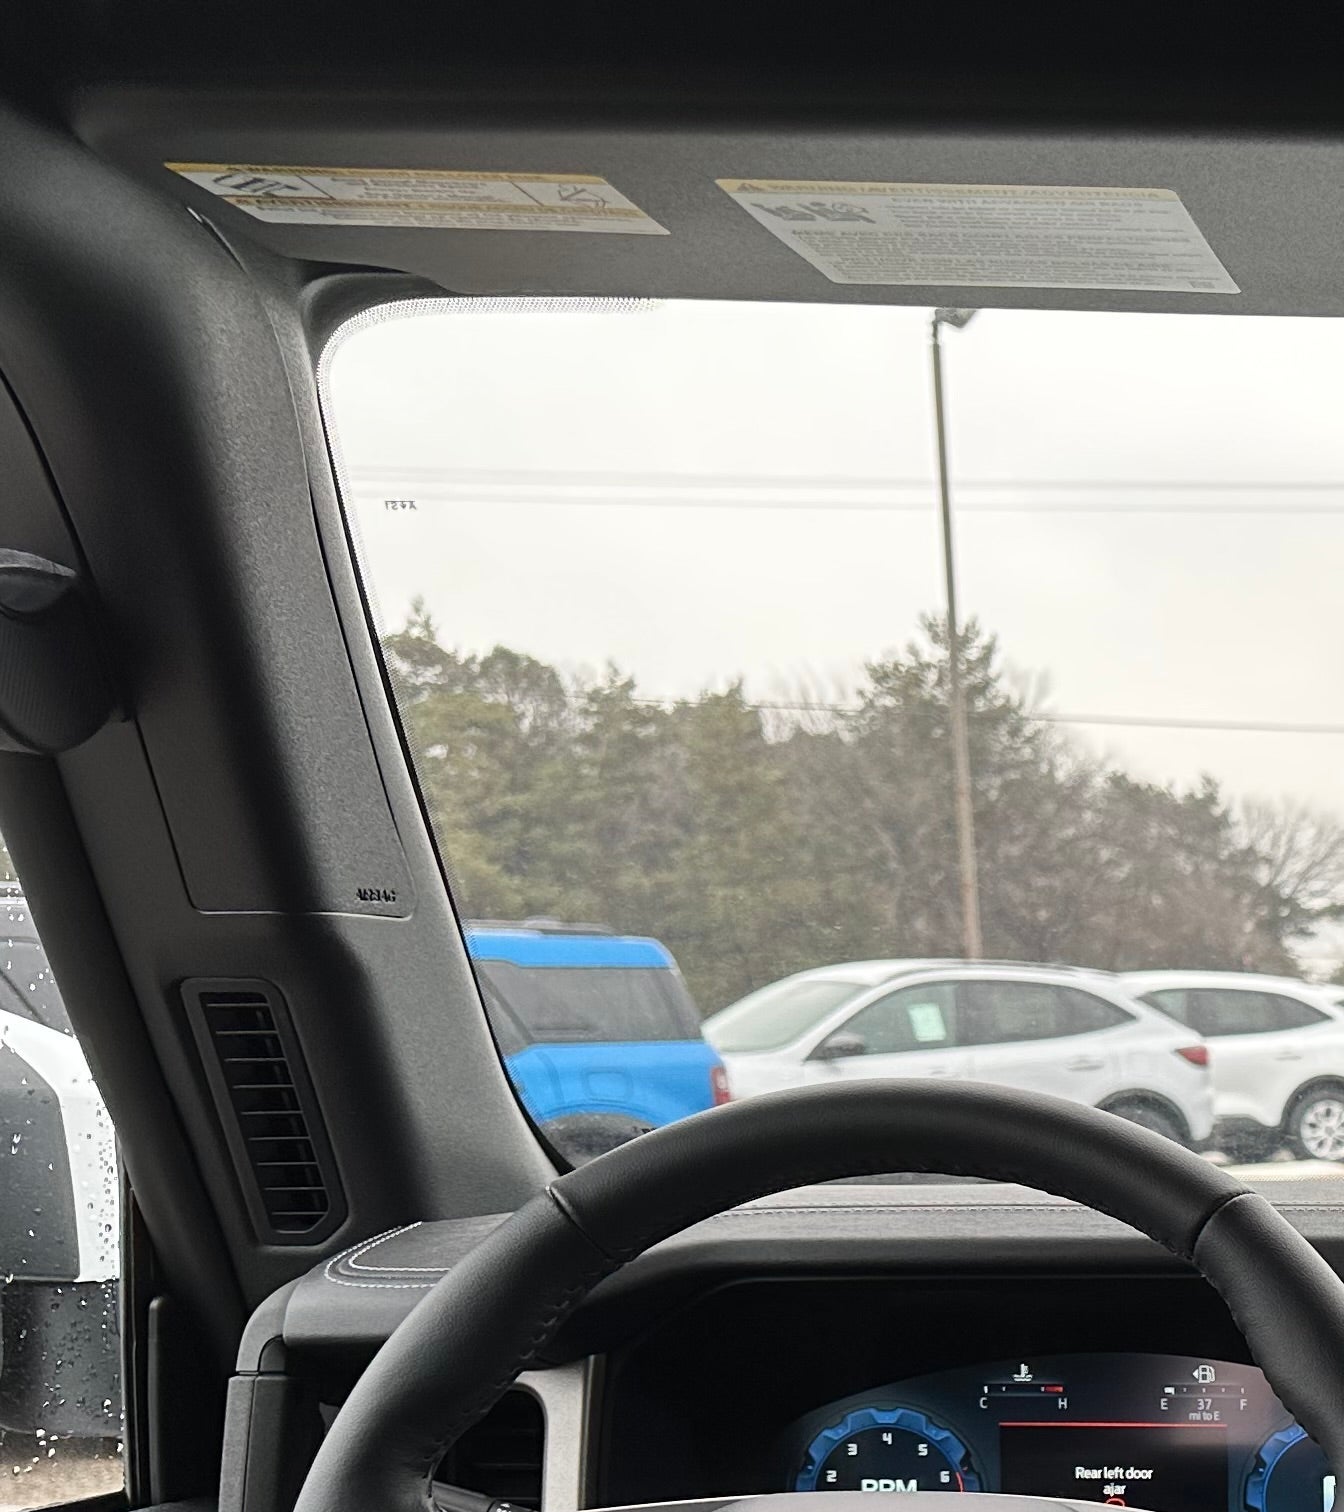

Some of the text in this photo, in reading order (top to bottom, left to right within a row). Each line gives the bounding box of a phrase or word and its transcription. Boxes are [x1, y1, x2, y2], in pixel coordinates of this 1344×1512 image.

[979, 1398, 988, 1409] C
[1058, 1398, 1067, 1409] H
[1160, 1398, 1168, 1410] E
[1197, 1398, 1212, 1410] 37
[1240, 1398, 1248, 1410] F
[1214, 1412, 1220, 1421] E
[881, 1433, 893, 1445] 4
[847, 1444, 858, 1456] 3
[918, 1444, 928, 1456] 5
[826, 1471, 837, 1483] 2
[940, 1470, 951, 1483] 6
[1075, 1466, 1153, 1480] Rear left door
[1103, 1483, 1126, 1497] ajar
